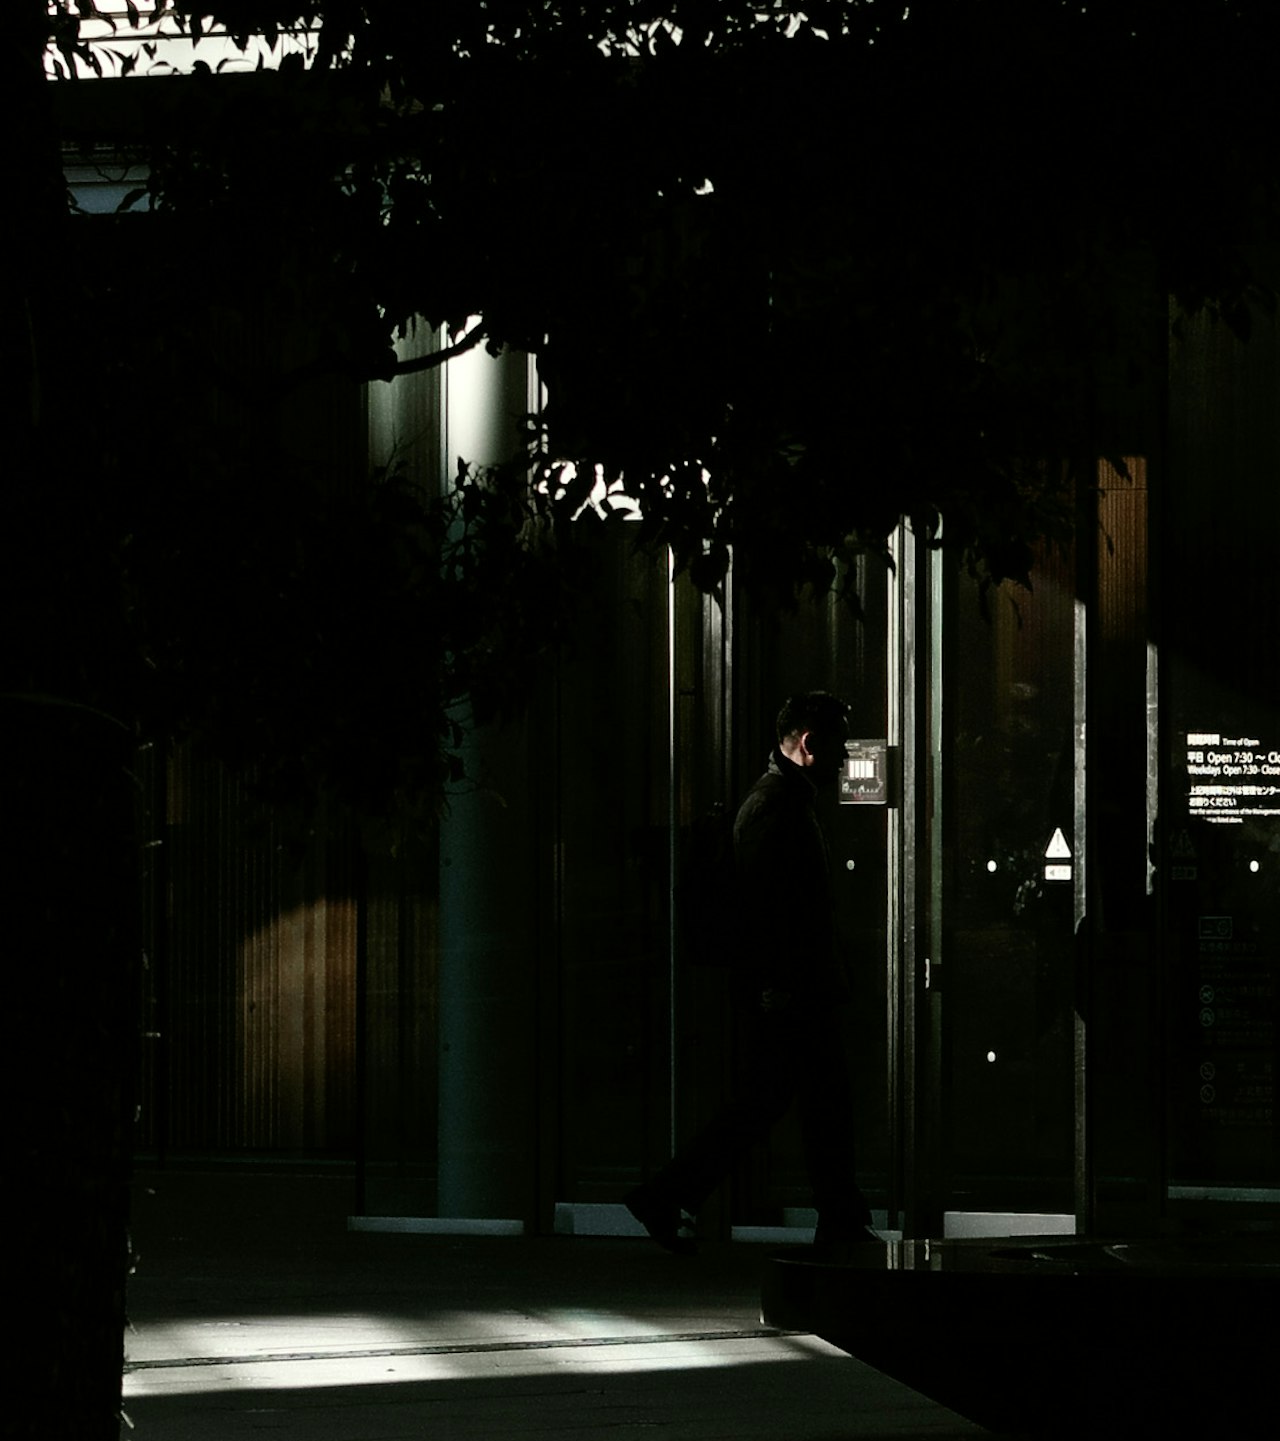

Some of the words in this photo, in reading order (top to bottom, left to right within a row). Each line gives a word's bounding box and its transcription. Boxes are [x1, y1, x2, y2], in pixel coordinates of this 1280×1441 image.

[1187, 751, 1203, 763] 平日
[1207, 752, 1232, 765] Open
[1234, 752, 1253, 763] 7:30
[1187, 765, 1221, 776] Weekdays
[1223, 765, 1241, 776] Open
[1261, 765, 1280, 774] Close
